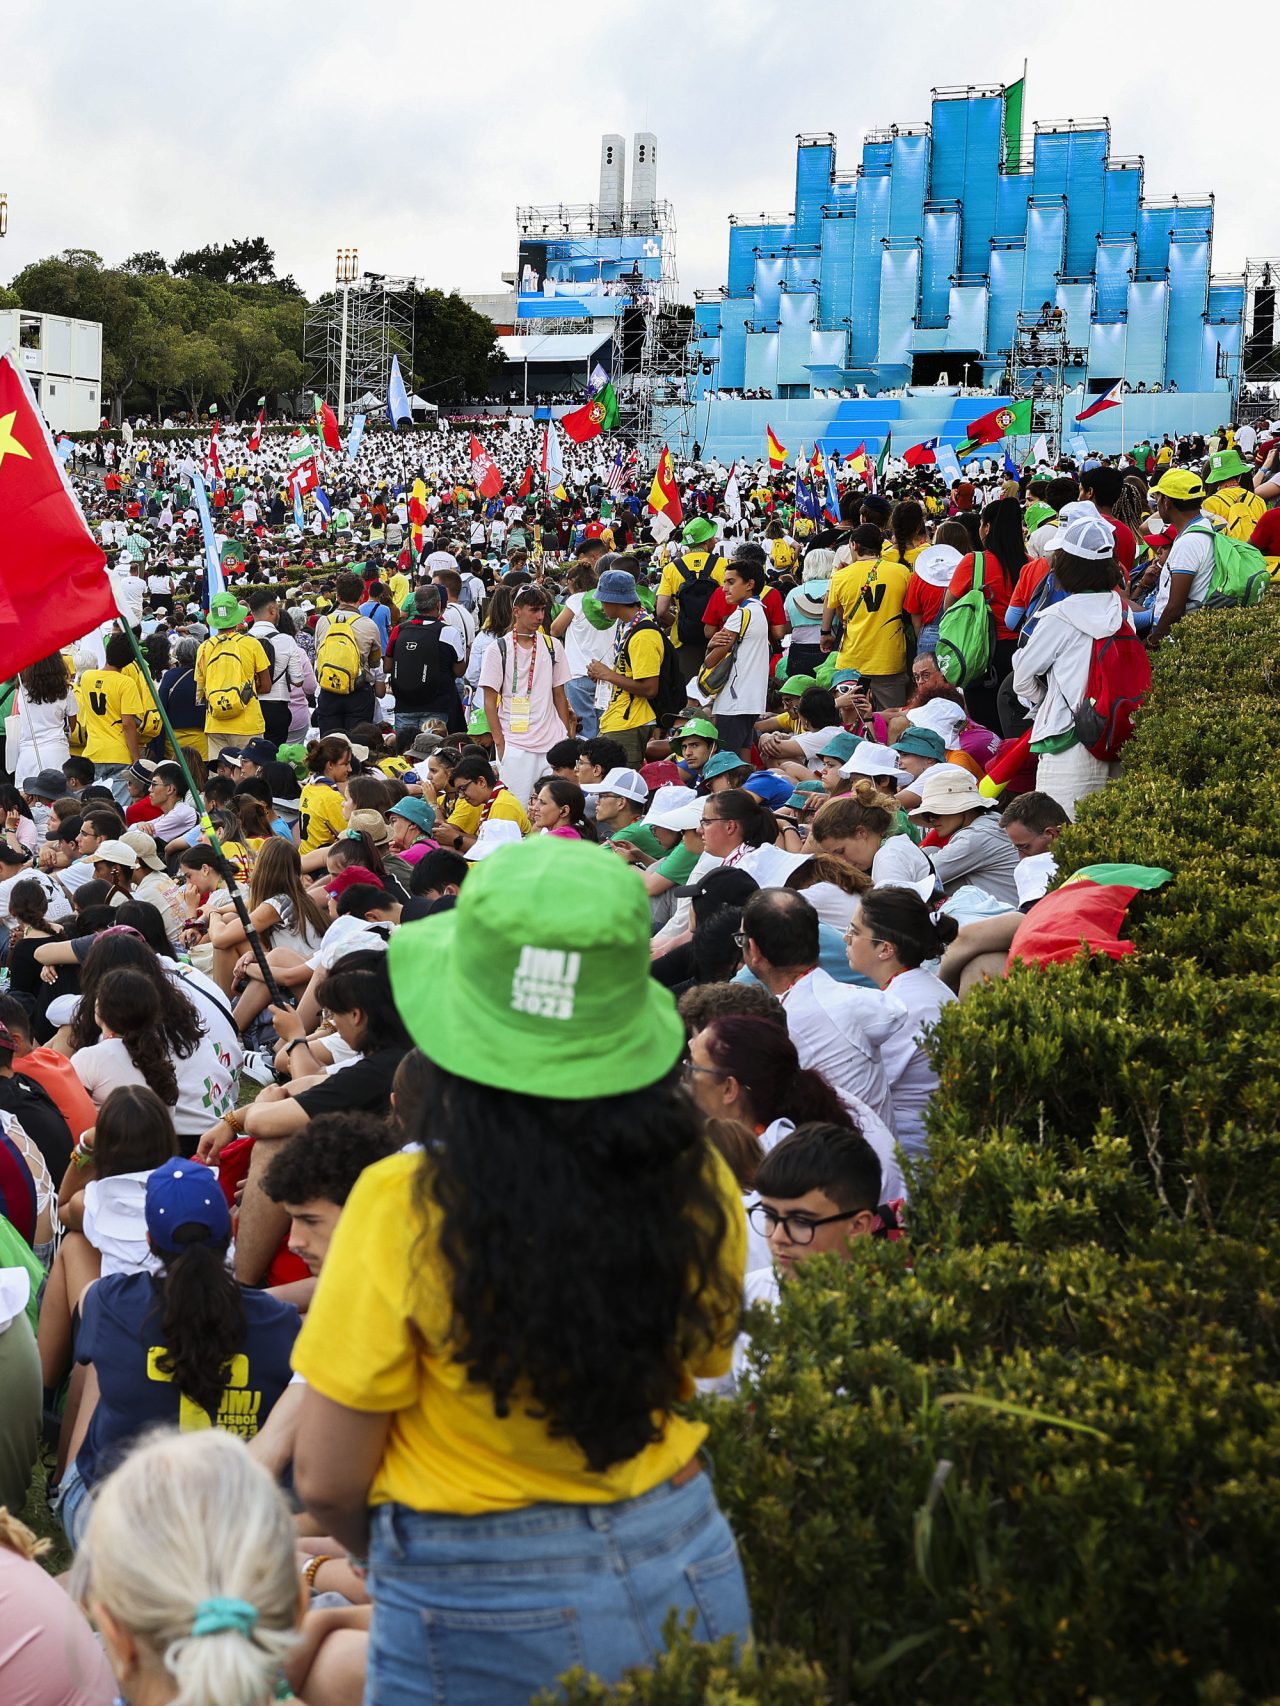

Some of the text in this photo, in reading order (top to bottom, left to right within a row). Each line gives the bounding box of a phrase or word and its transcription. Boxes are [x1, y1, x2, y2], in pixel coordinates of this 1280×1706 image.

[514, 944, 582, 984] JMJ
[511, 992, 575, 1021] 2023
[217, 1389, 262, 1415] JMJ
[217, 1414, 257, 1425] LISBOA
